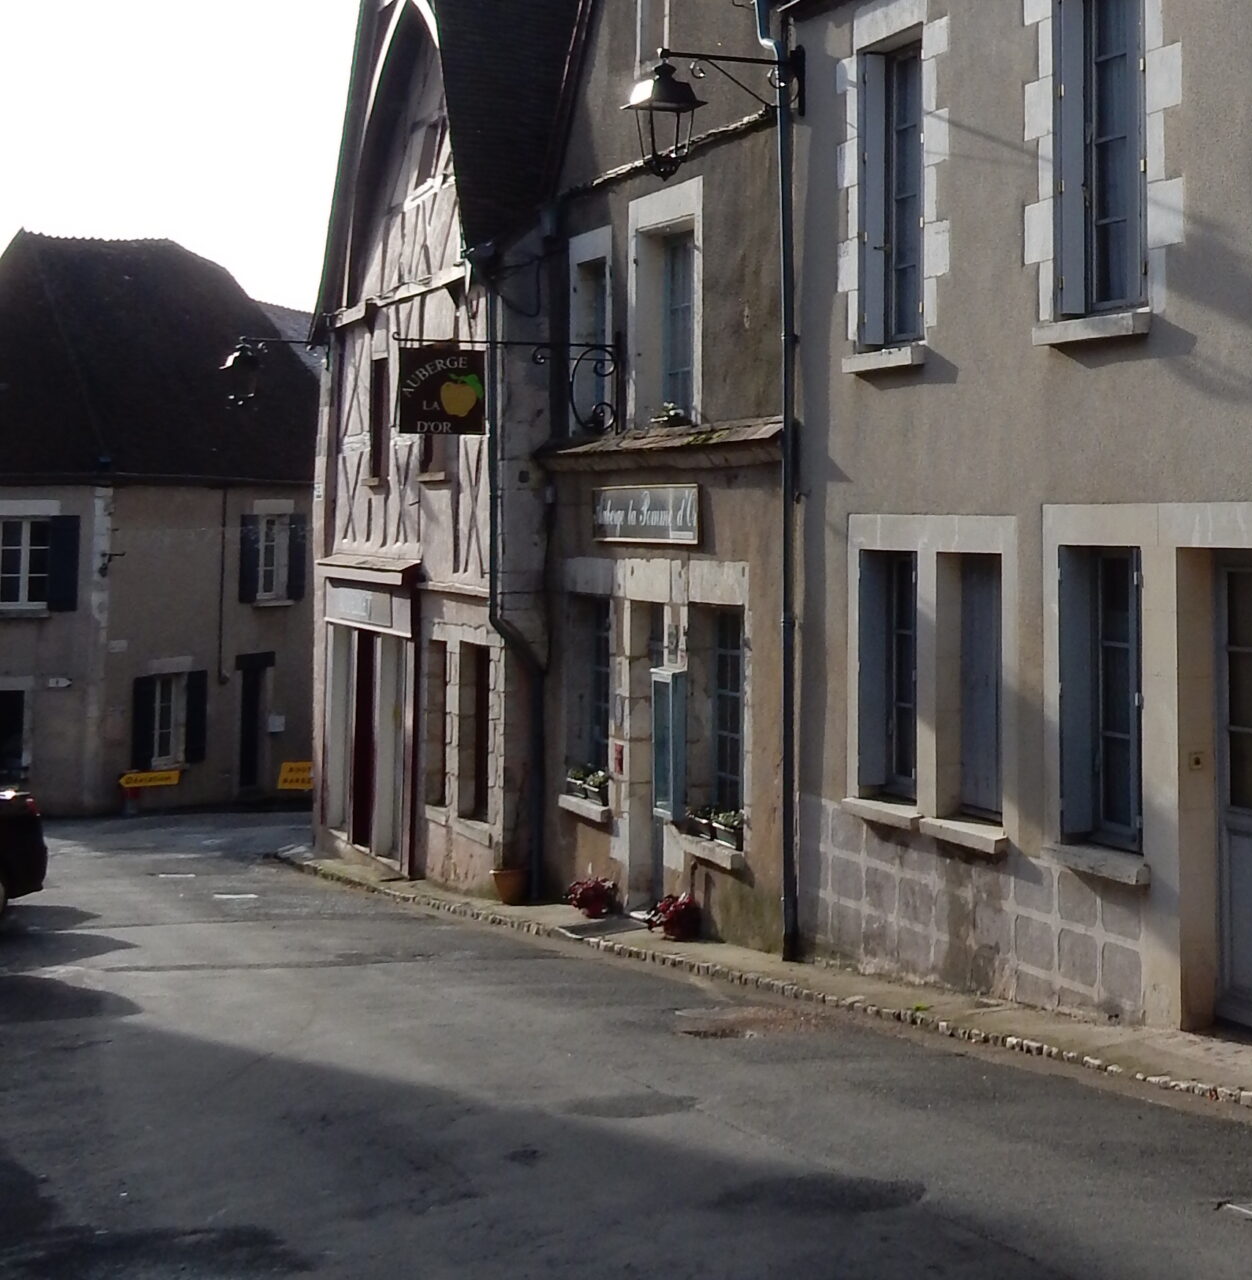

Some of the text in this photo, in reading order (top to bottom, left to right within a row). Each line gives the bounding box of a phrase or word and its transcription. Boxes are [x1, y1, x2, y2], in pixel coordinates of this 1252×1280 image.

[402, 356, 468, 397] AUBERGE
[423, 400, 440, 410] LA
[417, 421, 452, 433] D'OR
[627, 499, 637, 526] la
